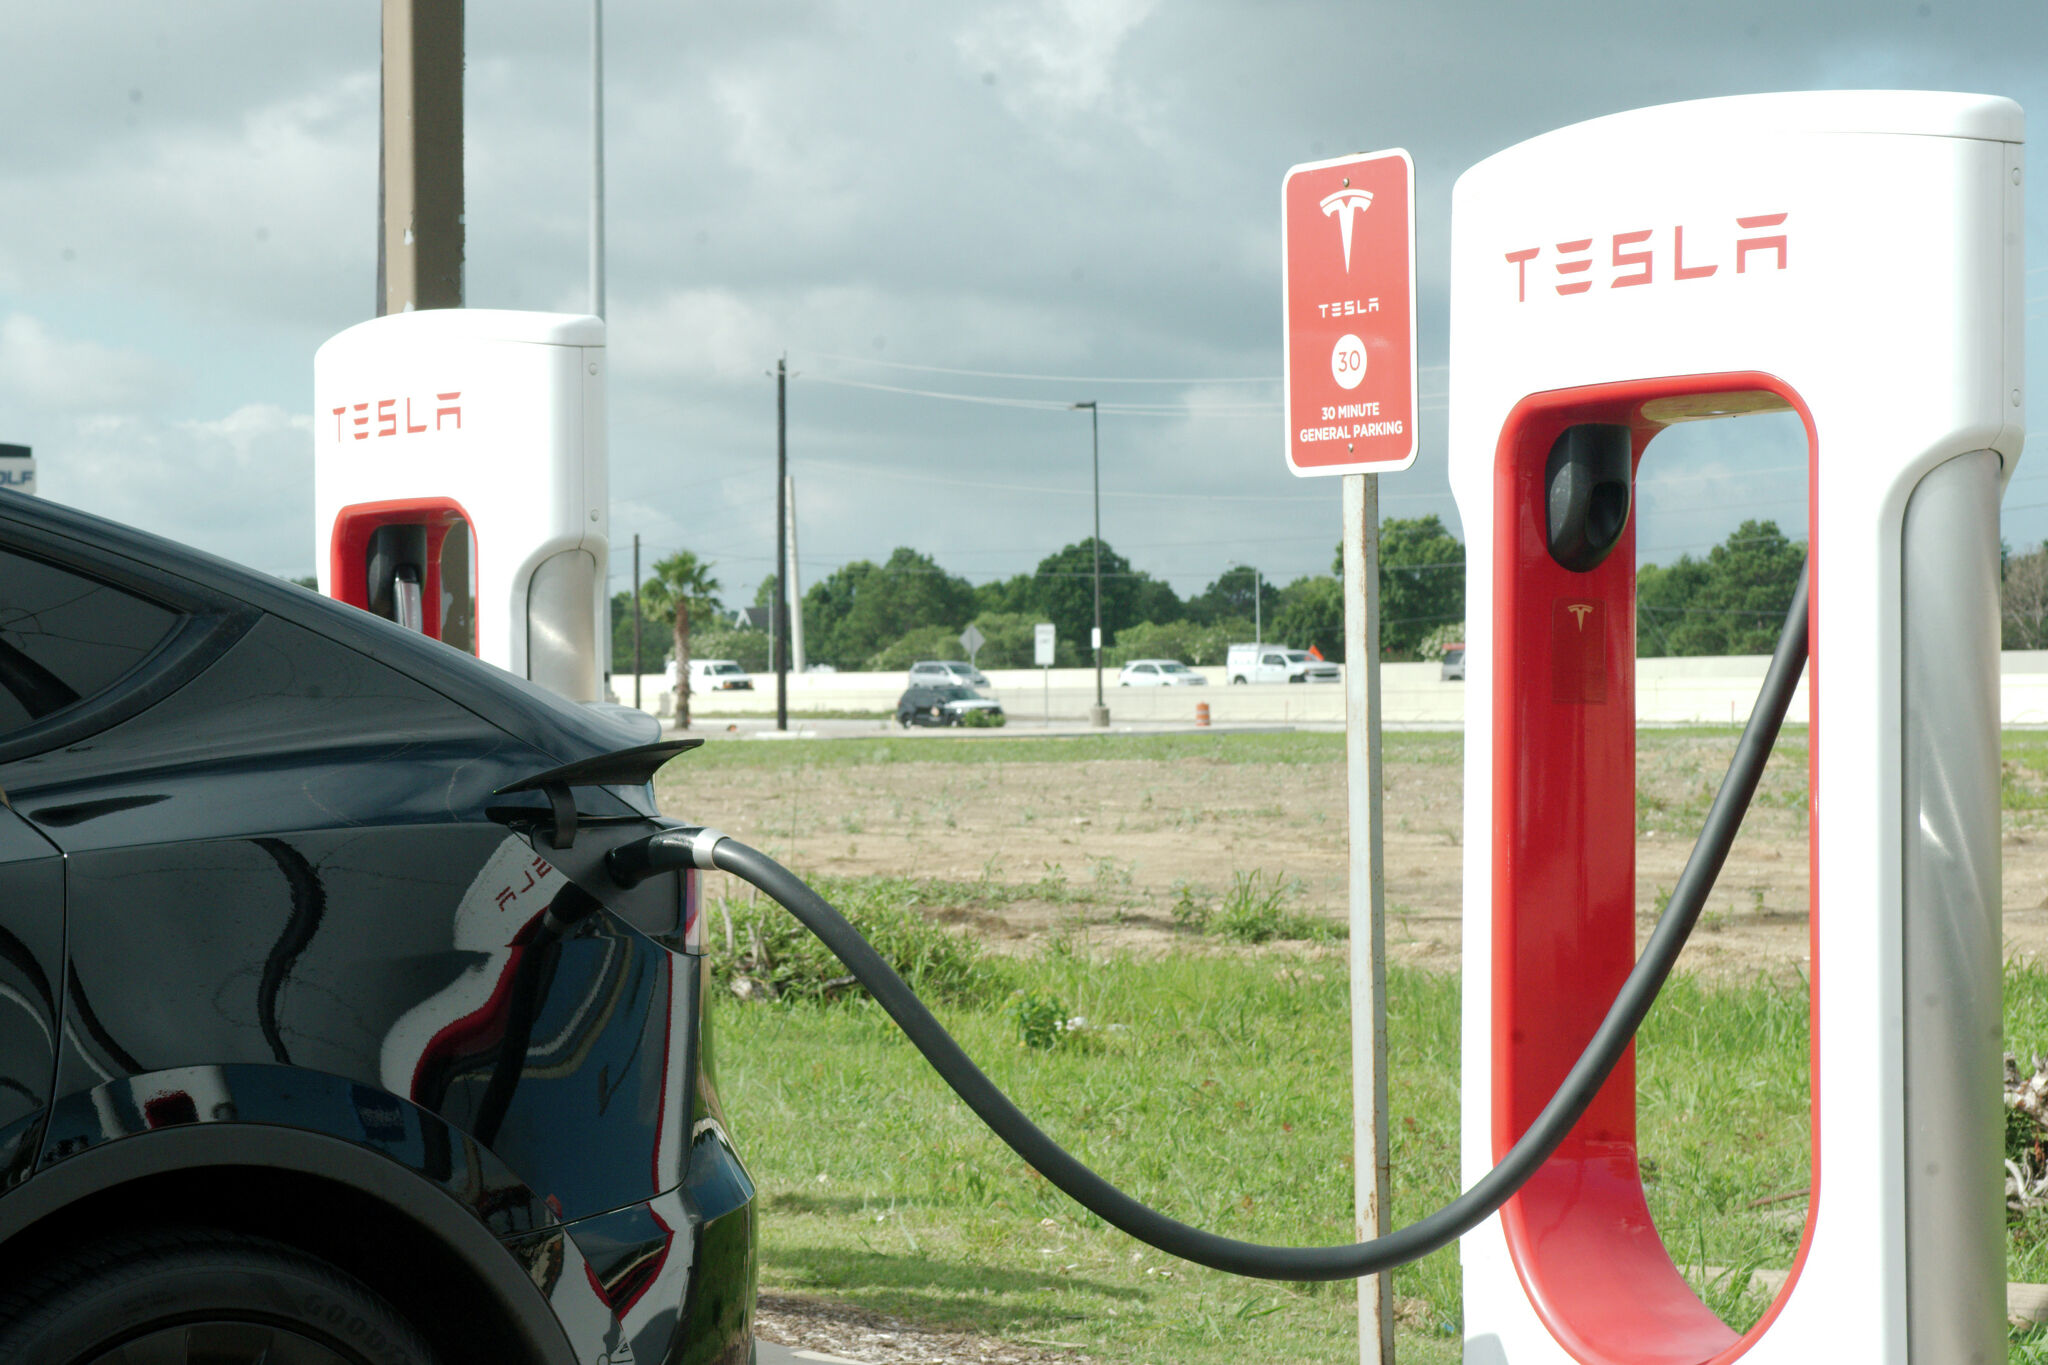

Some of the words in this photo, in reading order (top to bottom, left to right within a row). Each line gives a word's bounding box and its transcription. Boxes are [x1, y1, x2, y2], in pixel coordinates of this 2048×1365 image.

[1504, 212, 1788, 302] TESLA
[1318, 297, 1379, 319] TESLA
[1338, 350, 1361, 373] 30
[332, 391, 462, 443] TESLA
[1321, 406, 1336, 421] 30
[1337, 402, 1380, 419] MINUTE
[1300, 425, 1351, 443] GENERAL
[1353, 420, 1403, 438] PARKING
